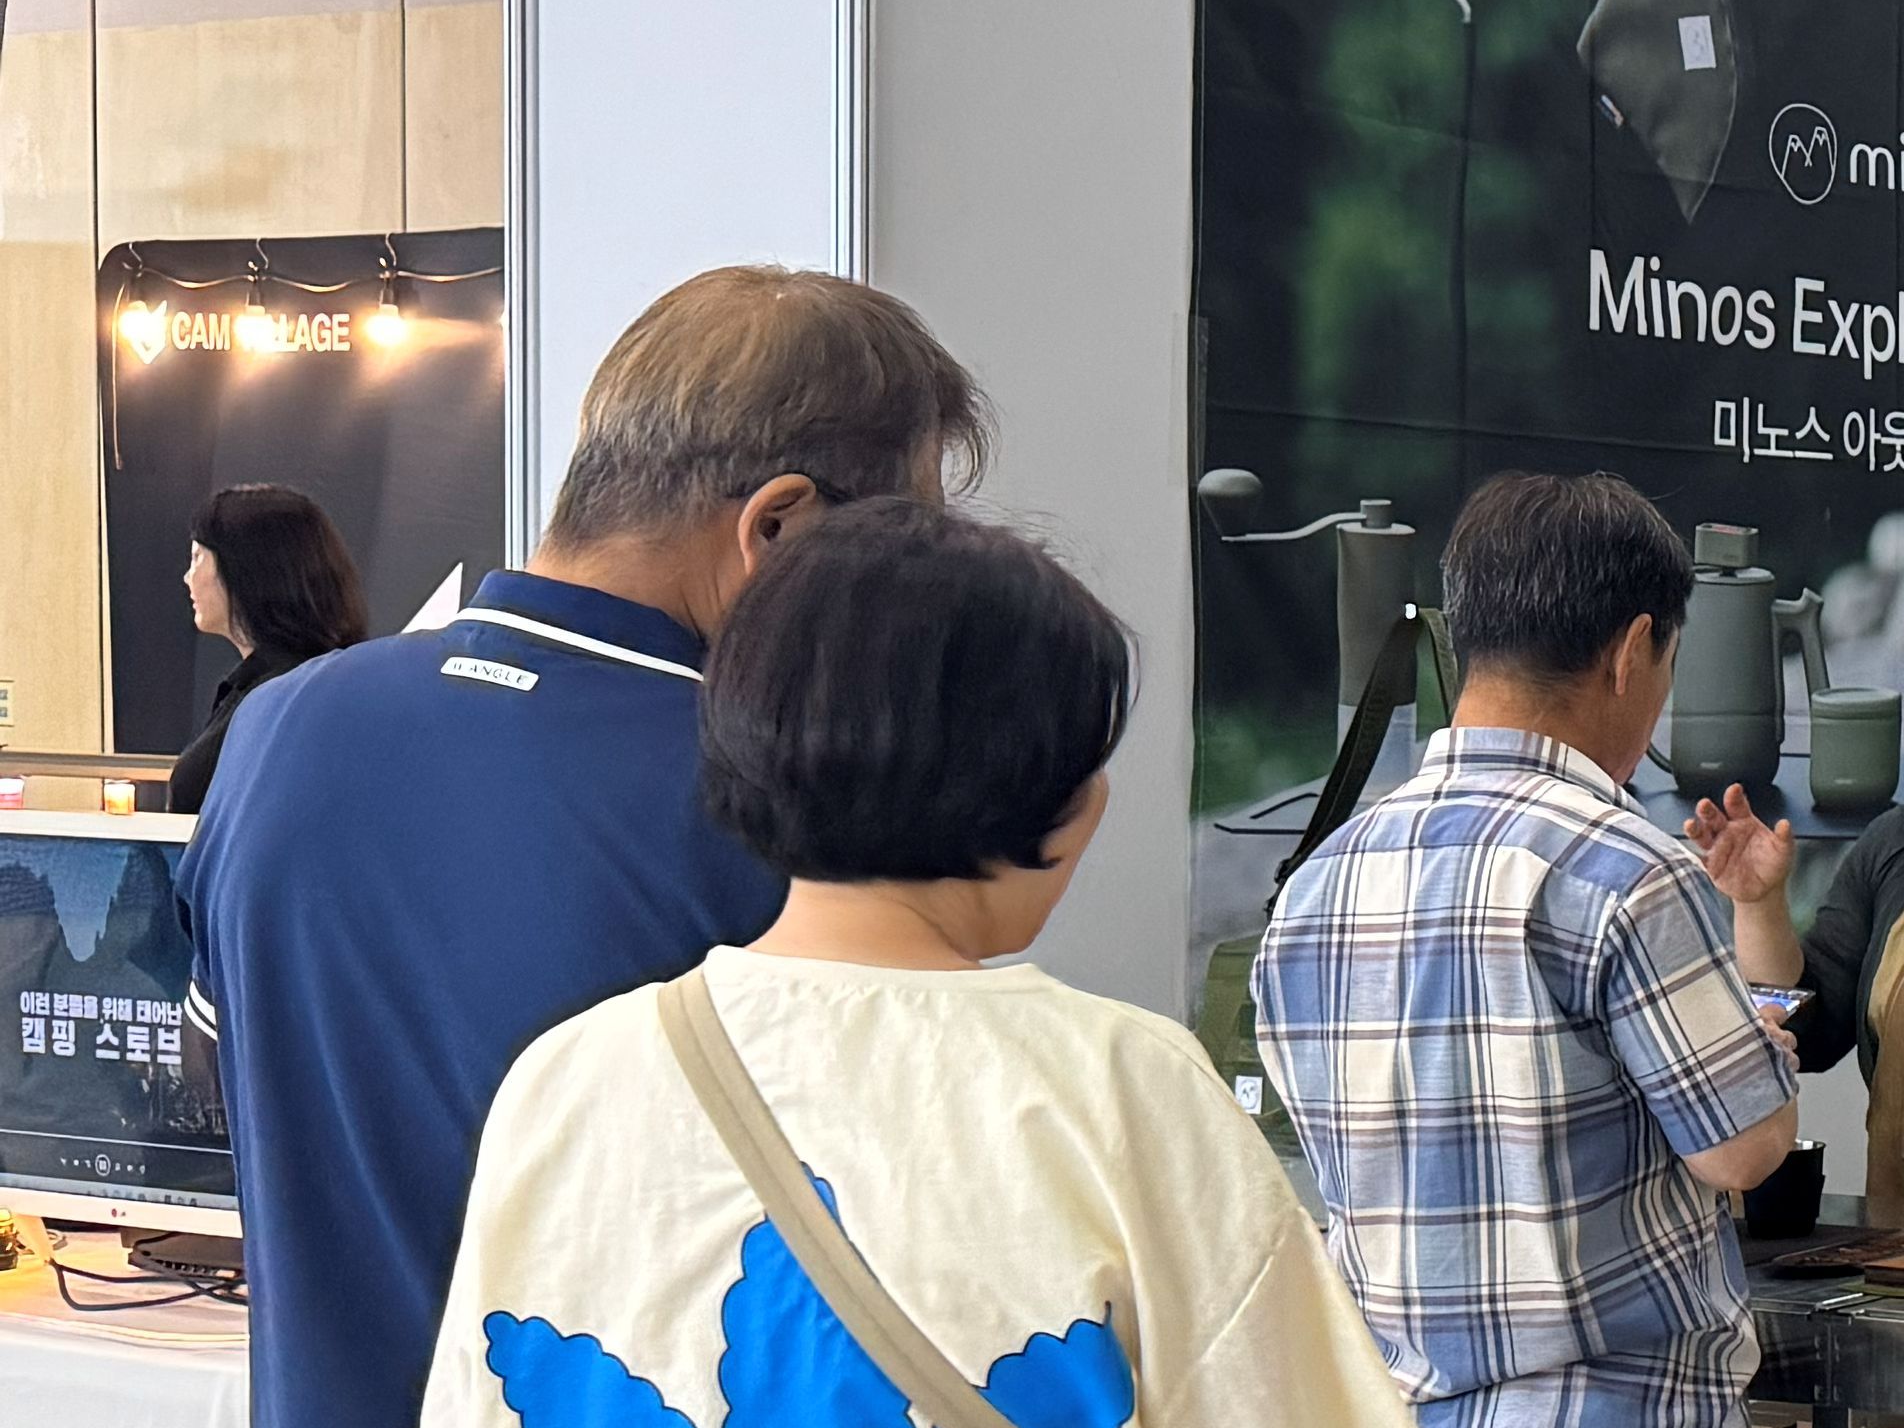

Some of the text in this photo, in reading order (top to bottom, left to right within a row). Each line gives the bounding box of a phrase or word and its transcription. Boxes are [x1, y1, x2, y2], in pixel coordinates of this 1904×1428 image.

[1588, 248, 1776, 351] Minos
[171, 311, 231, 351] CAM
[1712, 396, 1834, 464] 미노스
[20, 990, 50, 1015] 이런
[102, 997, 133, 1022] 위해
[137, 1000, 183, 1027] 태어난
[21, 1016, 183, 1066] 캠핑 스토브
